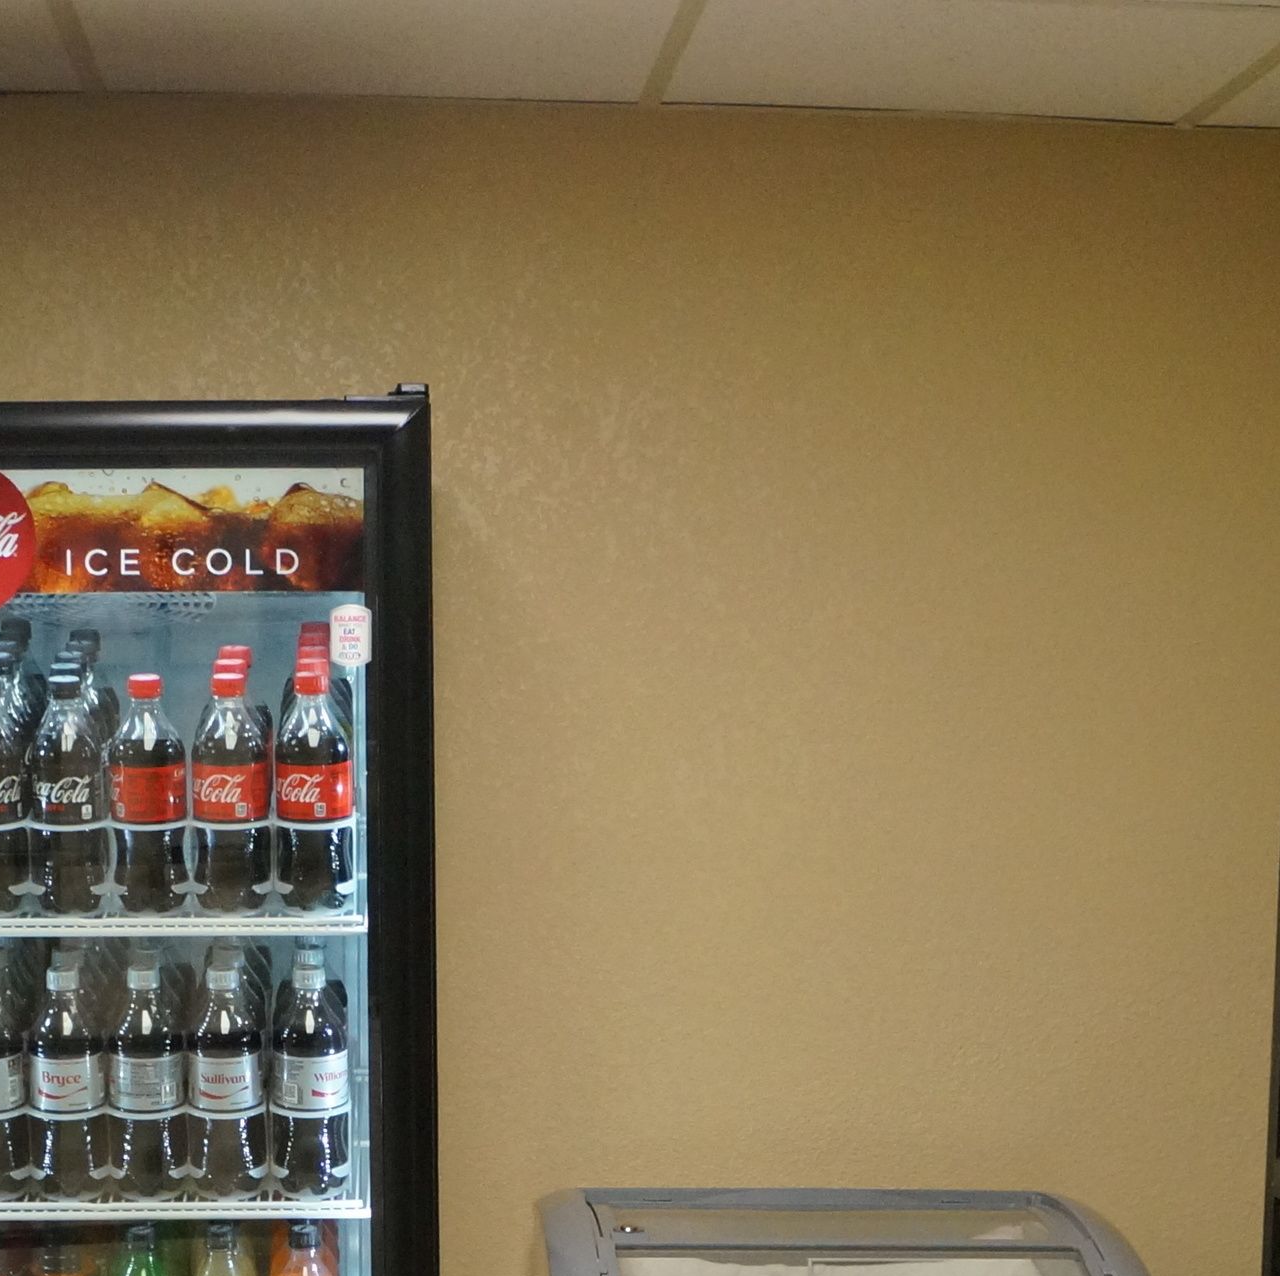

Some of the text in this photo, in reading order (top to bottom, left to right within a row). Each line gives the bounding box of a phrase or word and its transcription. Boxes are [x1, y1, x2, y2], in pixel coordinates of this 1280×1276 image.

[65, 548, 300, 576] ICE COLD
[42, 1071, 82, 1087] Bryce
[201, 1073, 247, 1084] Sullivan
